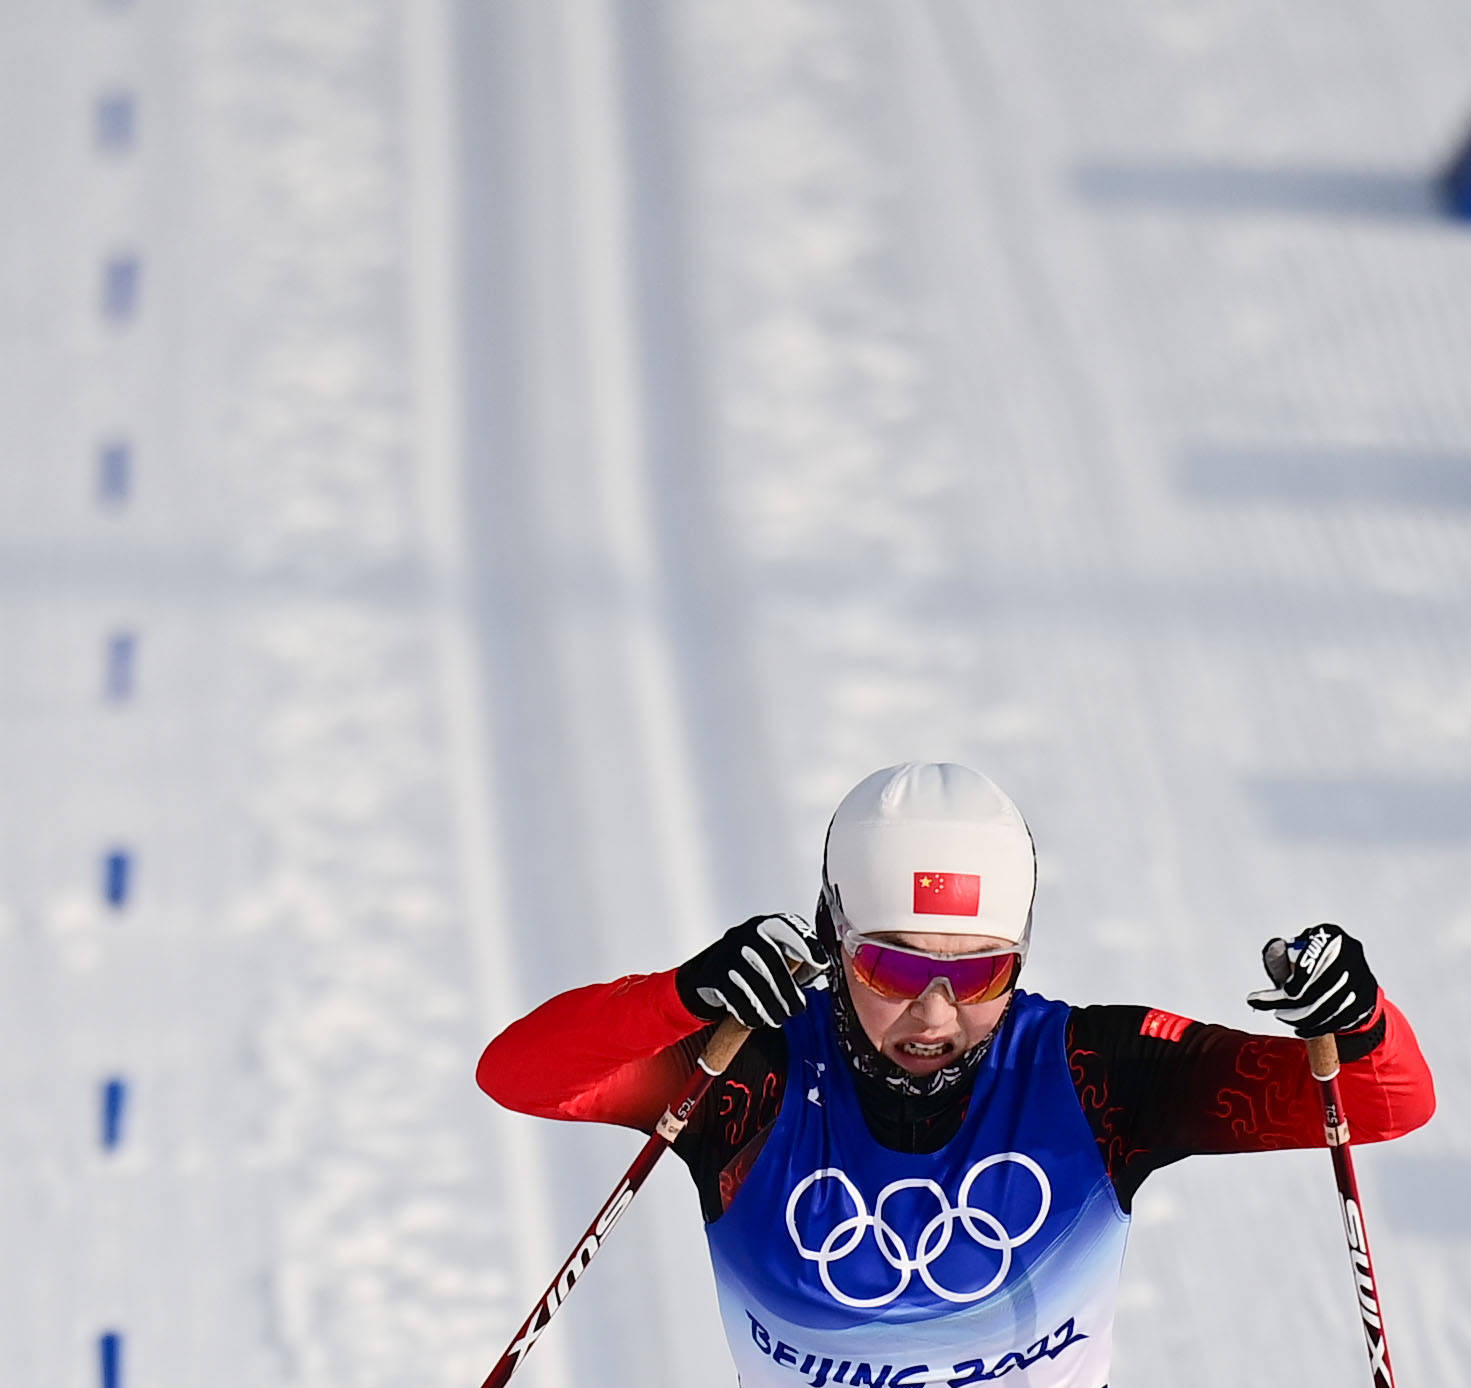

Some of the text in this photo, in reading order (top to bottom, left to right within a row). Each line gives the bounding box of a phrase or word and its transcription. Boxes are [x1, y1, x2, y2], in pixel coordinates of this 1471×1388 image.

[678, 1097, 695, 1120] TCS
[508, 1179, 633, 1371] SWIX
[1339, 1191, 1392, 1388] SWIX
